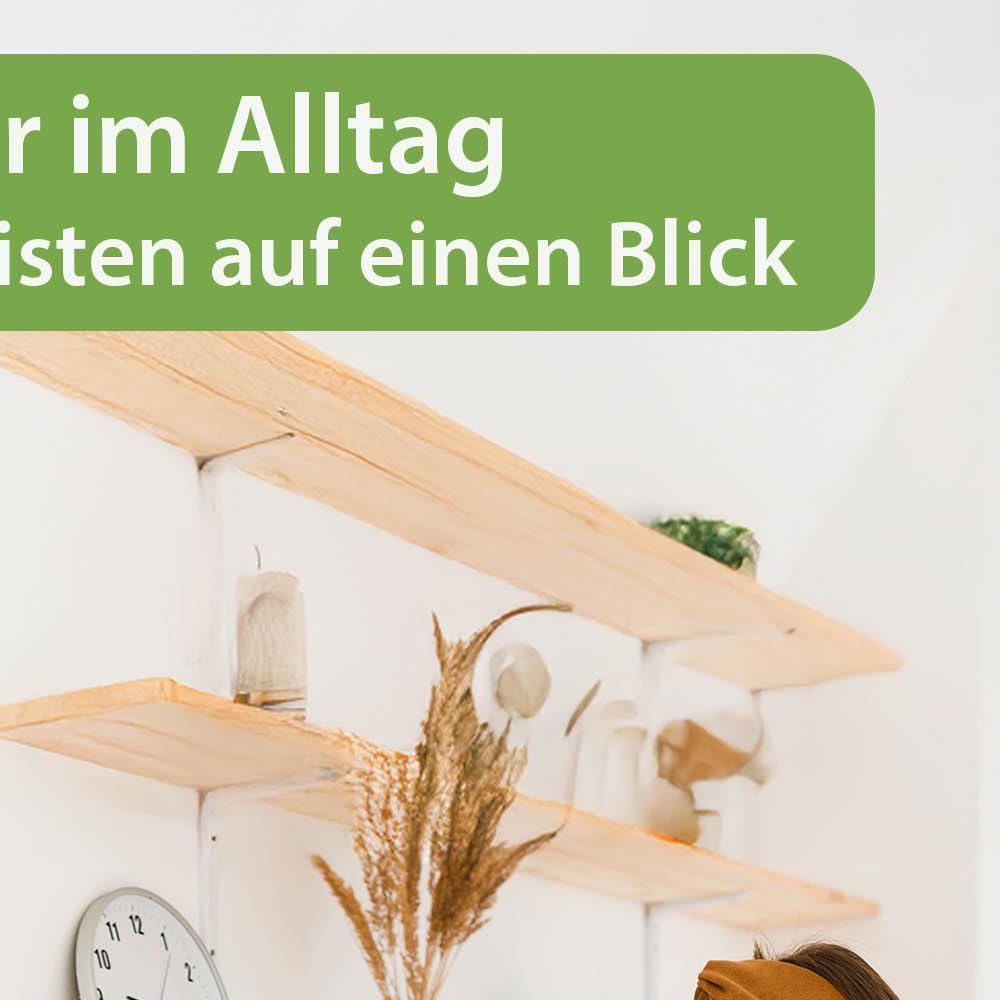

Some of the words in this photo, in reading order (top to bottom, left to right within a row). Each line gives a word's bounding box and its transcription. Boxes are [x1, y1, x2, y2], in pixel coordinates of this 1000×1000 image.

[106, 921, 120, 942] 11
[129, 915, 144, 935] 12
[161, 932, 168, 951] 1
[94, 949, 111, 970] 10
[185, 963, 194, 982] 2
